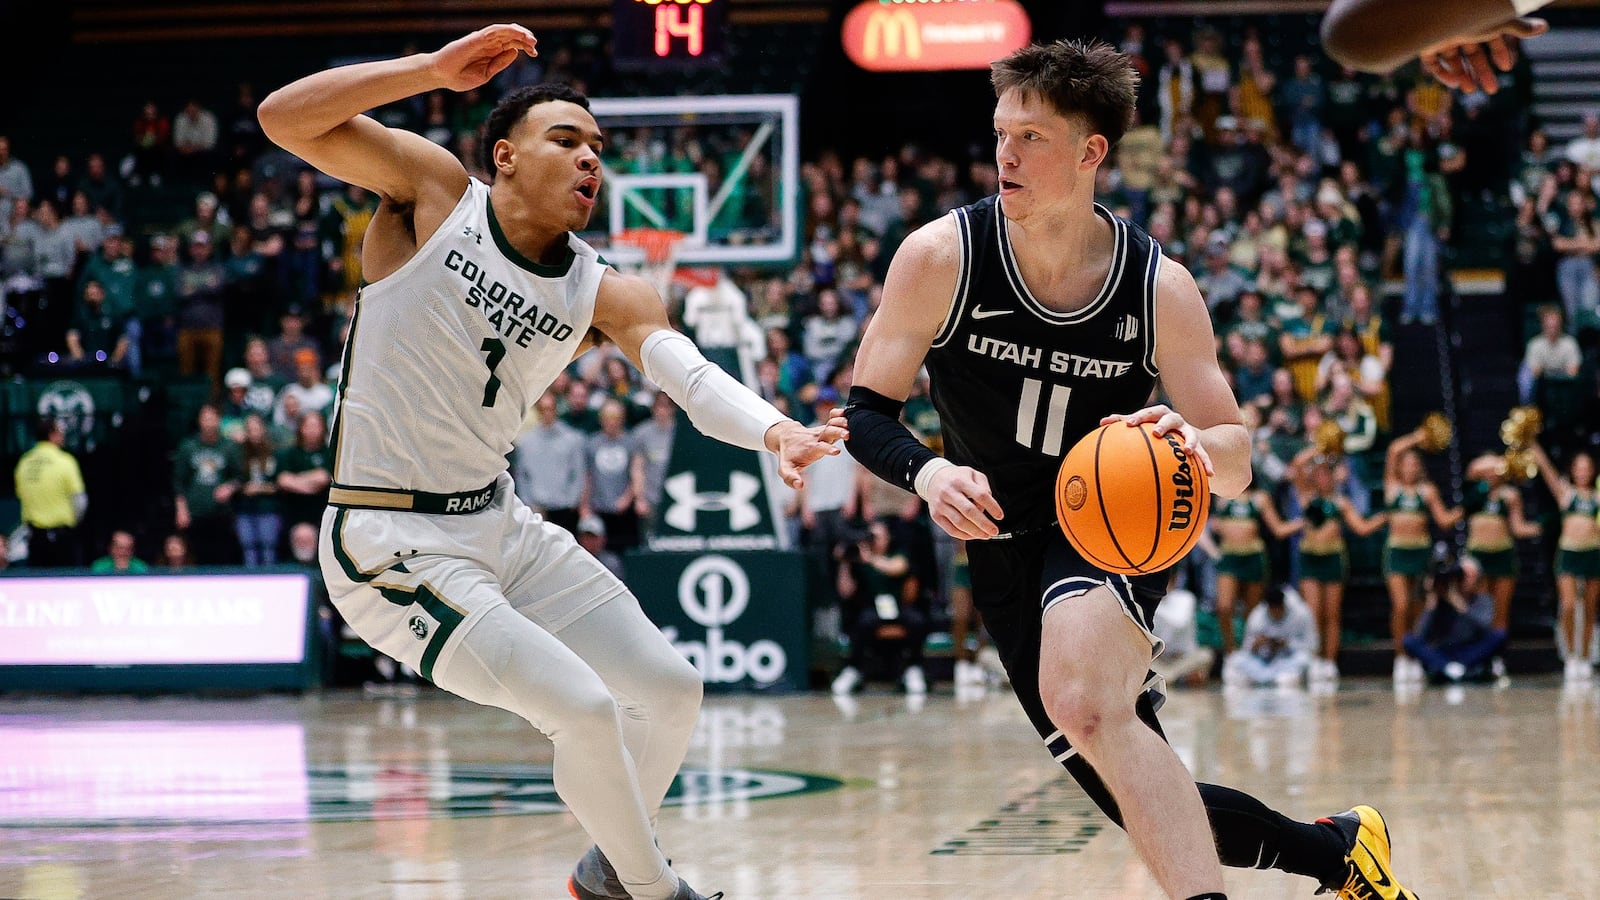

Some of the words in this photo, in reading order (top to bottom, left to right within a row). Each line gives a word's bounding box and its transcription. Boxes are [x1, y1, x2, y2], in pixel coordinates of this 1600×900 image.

[654, 4, 703, 57] 14
[444, 249, 574, 342] COLORADO
[465, 286, 537, 349] STATE
[480, 337, 507, 408] 1
[967, 333, 1043, 369] UTAH
[1050, 351, 1134, 379] STATE
[1015, 377, 1072, 457] 11
[445, 489, 492, 513] RAMS
[1164, 433, 1195, 532] Wilson
[91, 590, 265, 628] WILLIAMS
